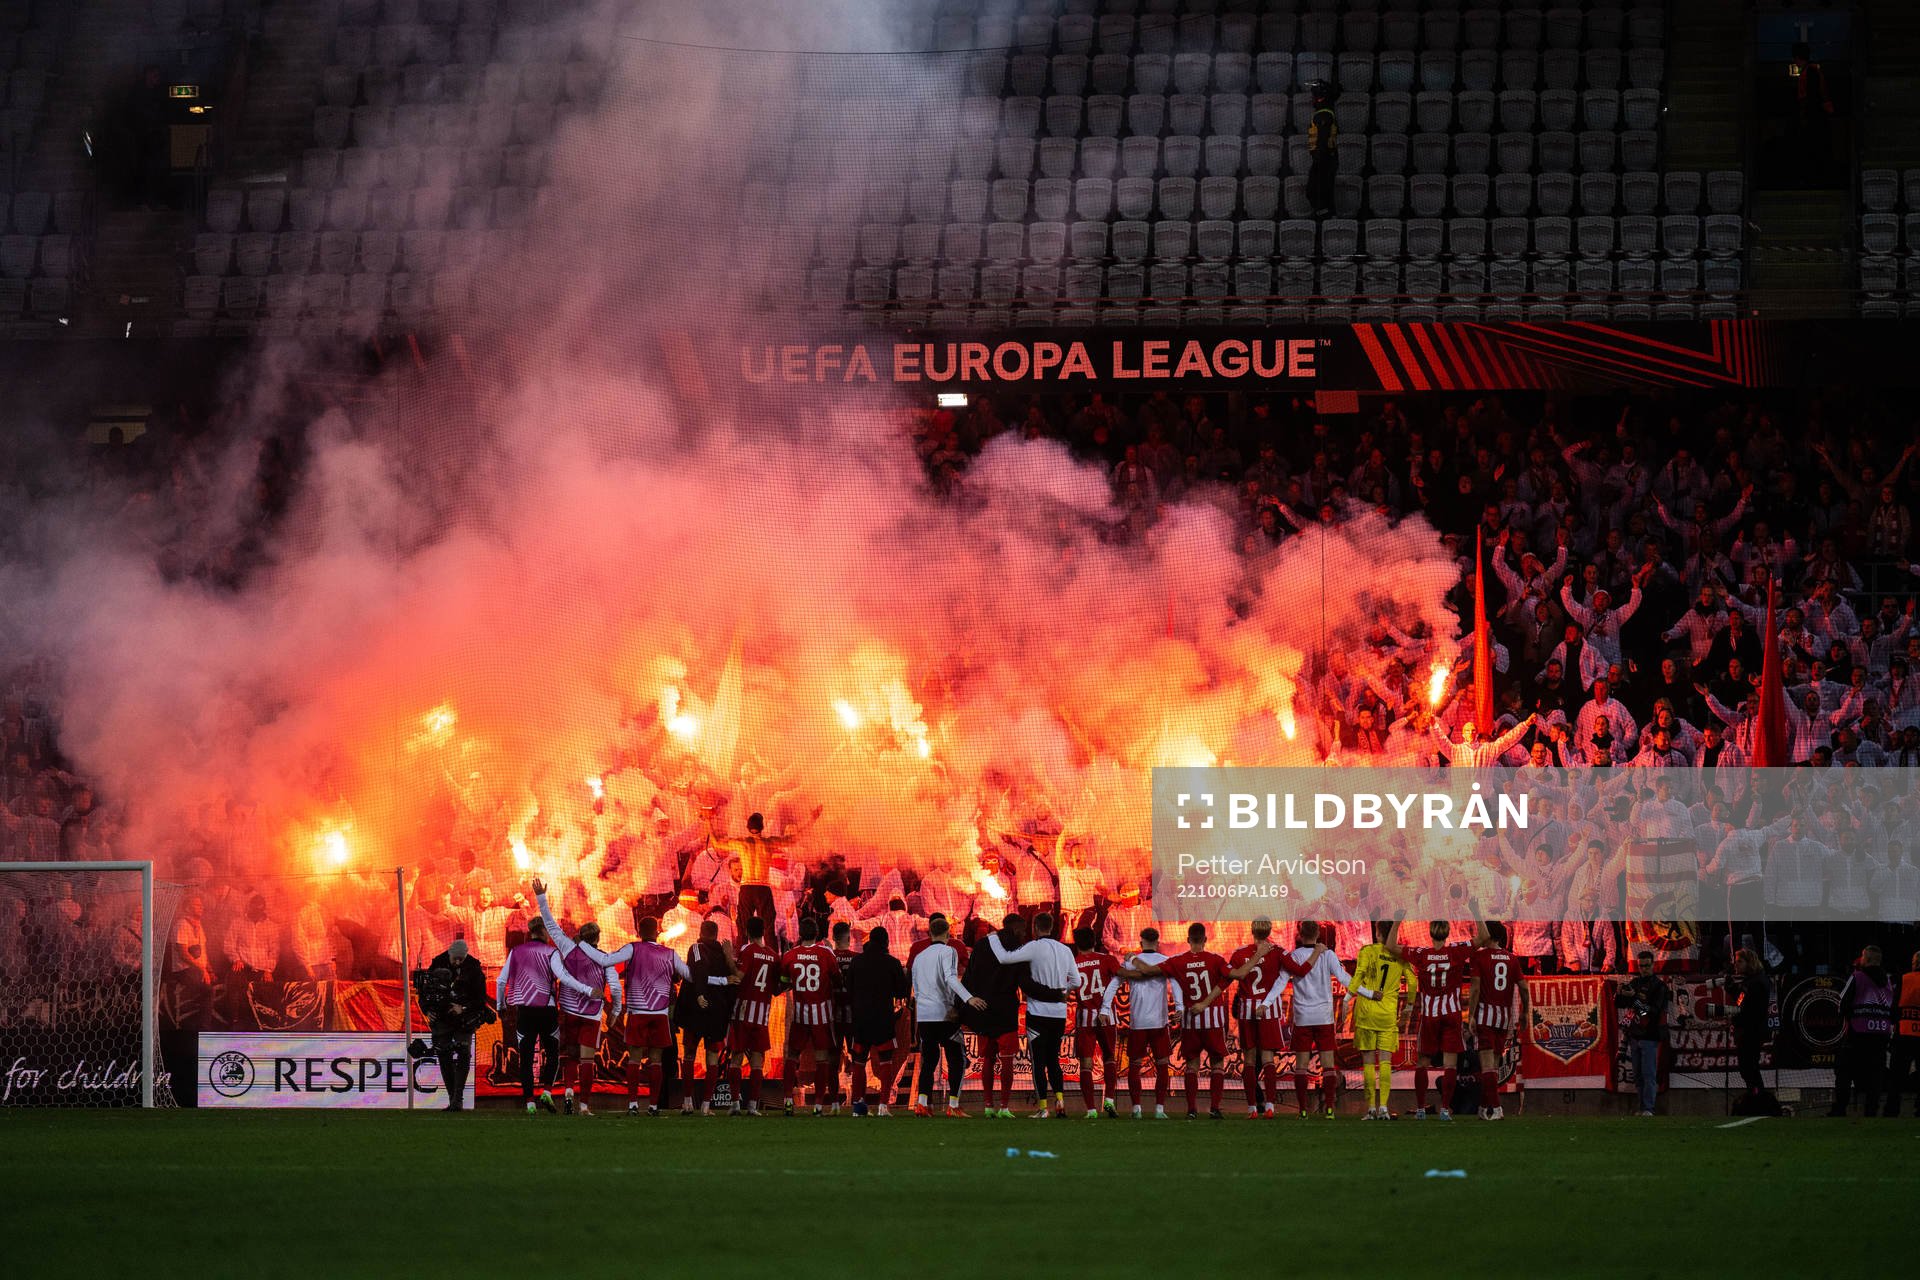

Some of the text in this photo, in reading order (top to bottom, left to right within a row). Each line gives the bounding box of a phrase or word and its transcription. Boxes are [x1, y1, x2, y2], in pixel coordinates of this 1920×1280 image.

[740, 344, 877, 384] UEFA
[894, 341, 1097, 382] EUROPA
[1113, 339, 1317, 378] LEAGUE
[754, 964, 769, 992] 4
[793, 963, 820, 992] 28
[1080, 969, 1105, 1001] 24
[1186, 969, 1212, 1001] 31
[1250, 966, 1266, 995] 2
[1380, 964, 1390, 991] 1
[1426, 962, 1451, 988] 17
[1493, 962, 1508, 992] 8
[1529, 982, 1599, 1006] UNION
[1867, 1019, 1888, 1031] 019
[2, 1056, 173, 1101] for childrn
[274, 1057, 439, 1093] RESPEC
